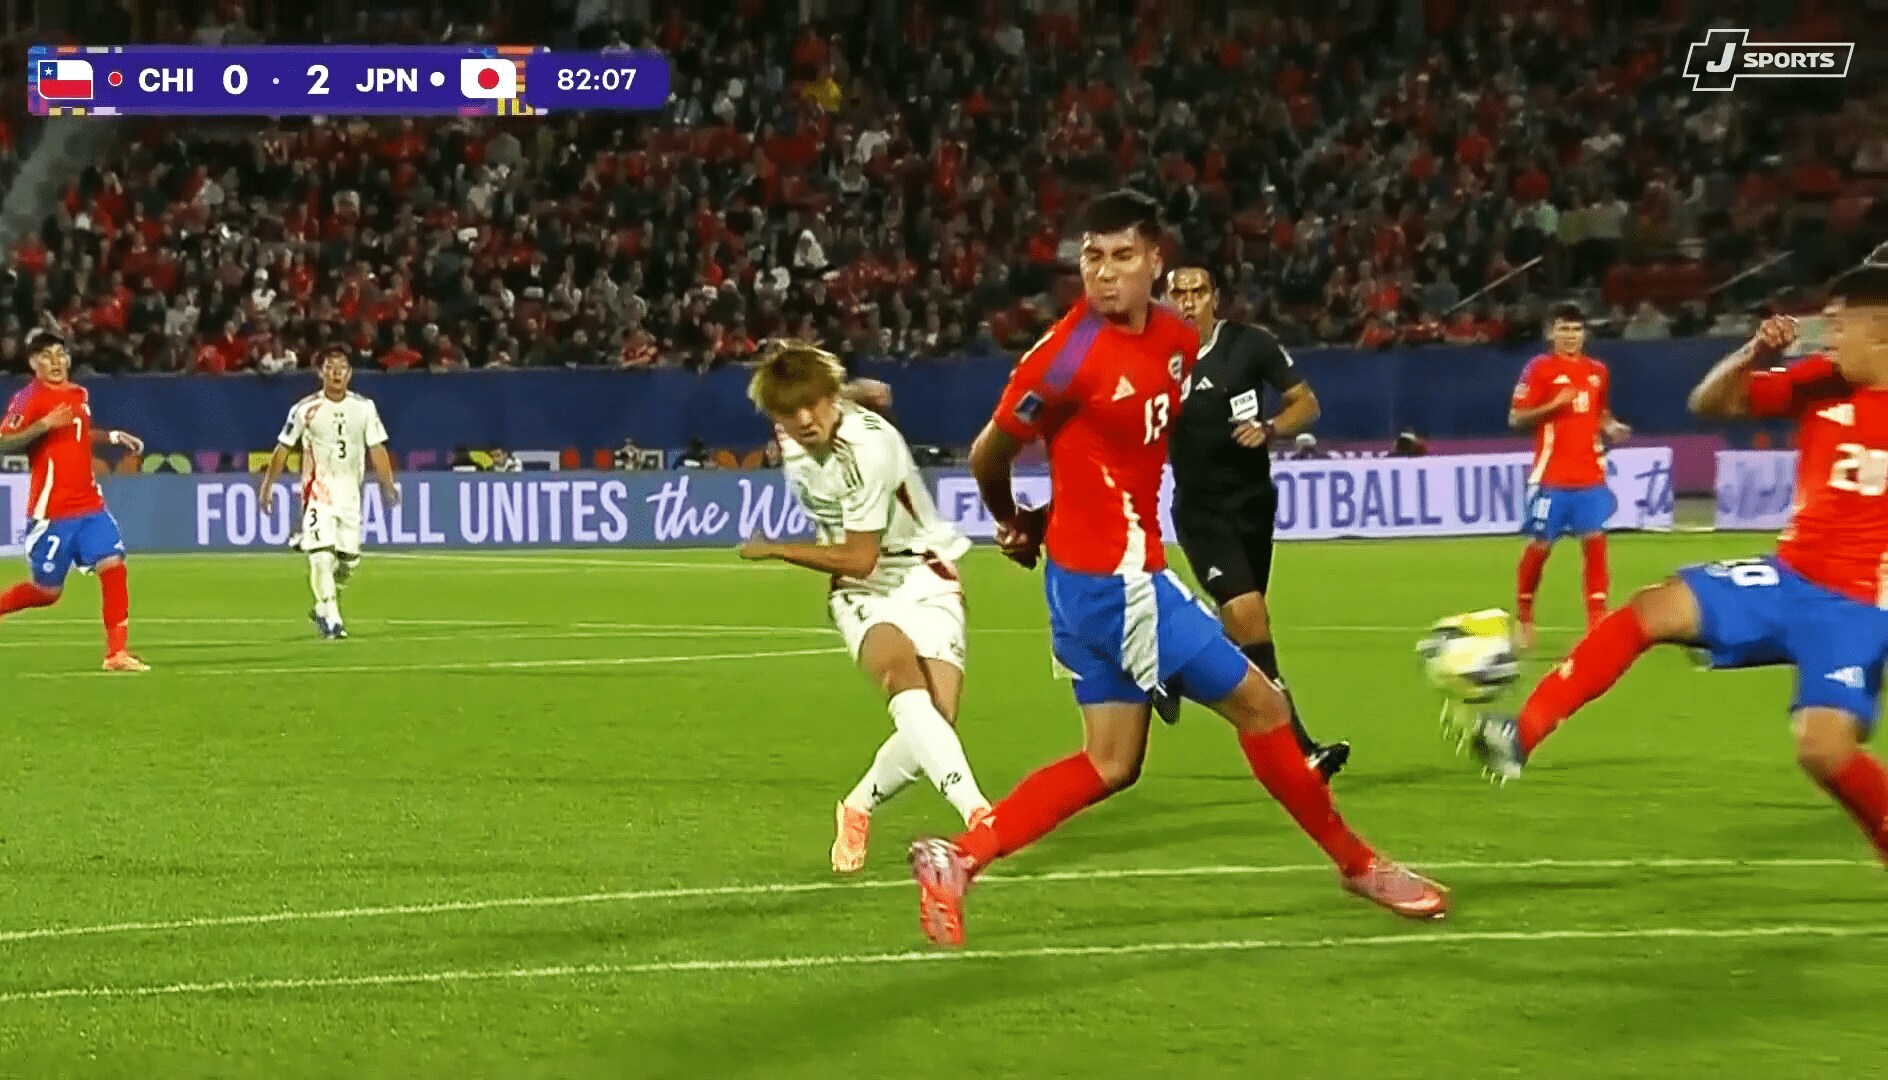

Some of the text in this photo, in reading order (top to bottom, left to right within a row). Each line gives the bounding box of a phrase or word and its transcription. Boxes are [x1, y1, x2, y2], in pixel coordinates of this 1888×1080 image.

[1143, 392, 1170, 446] 13
[336, 439, 347, 460] 3
[196, 482, 446, 546] FOOALL
[459, 480, 629, 544] UNITES
[646, 475, 730, 541] the
[309, 507, 318, 528] 3
[1273, 468, 1443, 531] OTBALL
[47, 534, 61, 560] 7
